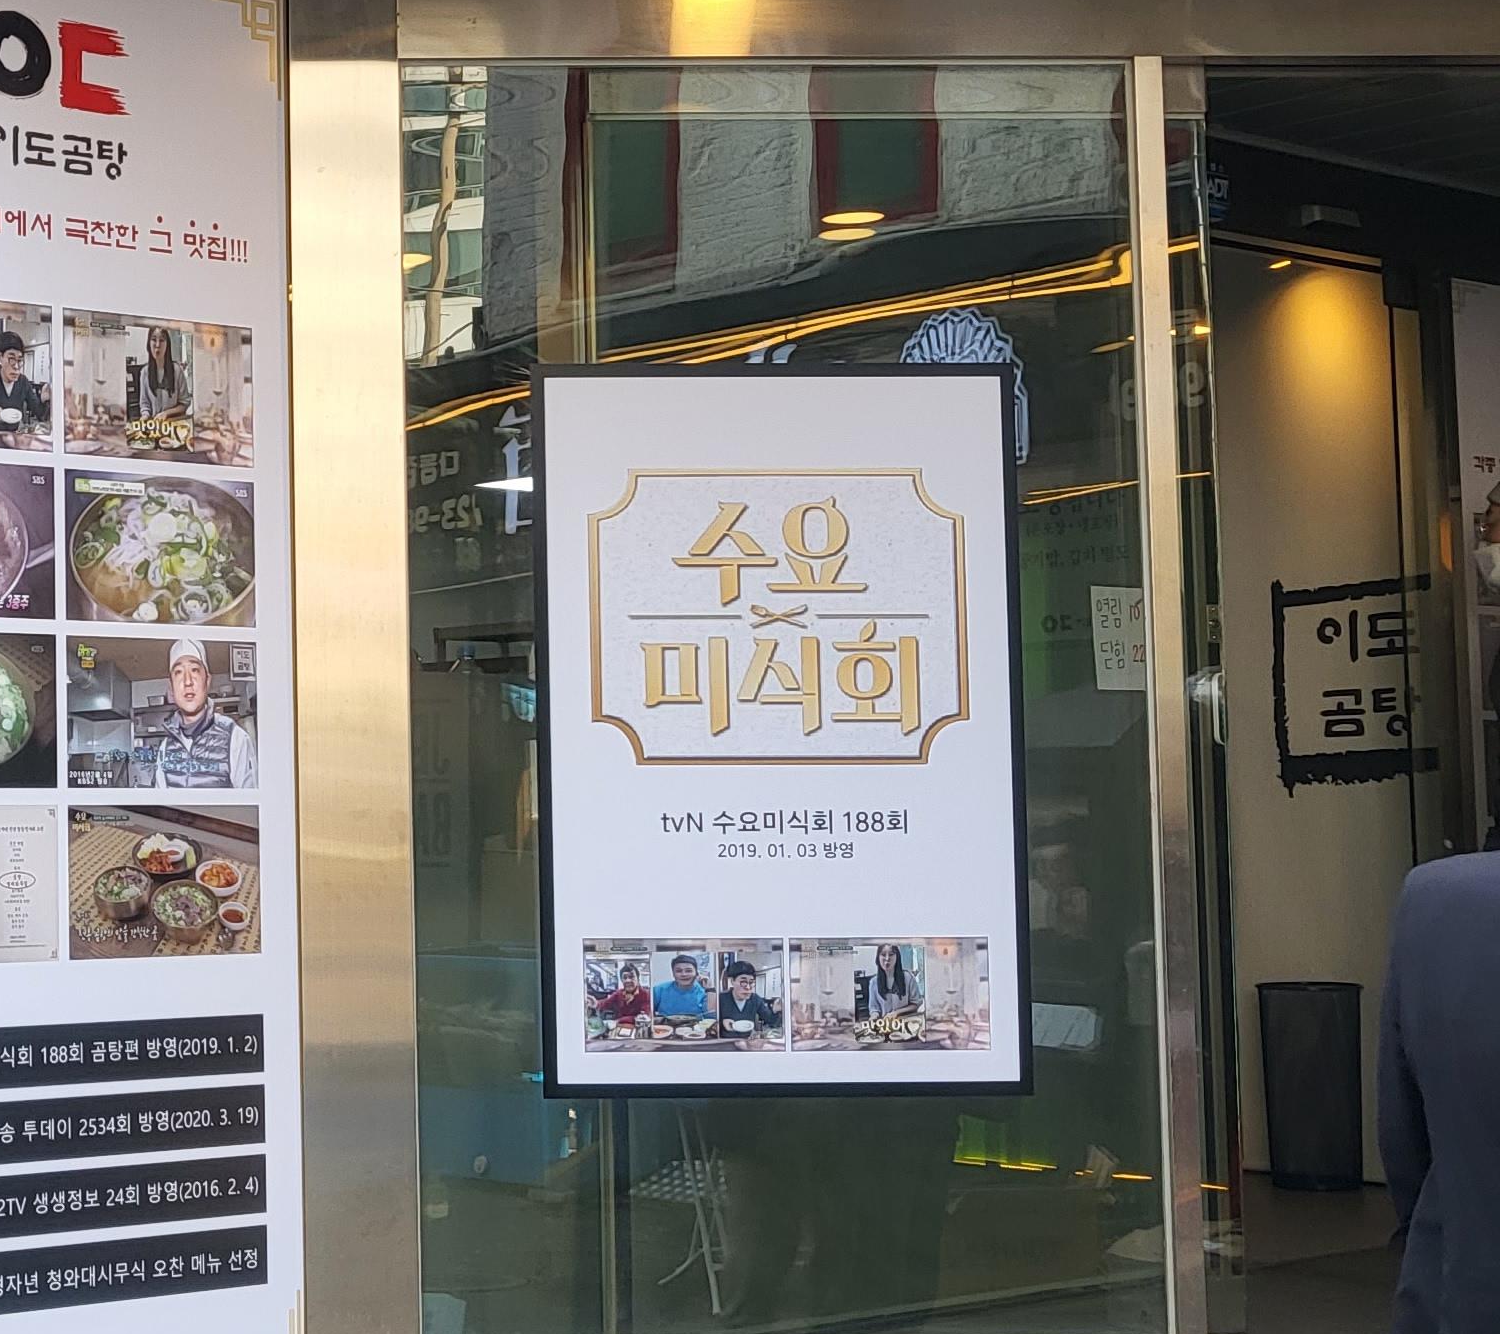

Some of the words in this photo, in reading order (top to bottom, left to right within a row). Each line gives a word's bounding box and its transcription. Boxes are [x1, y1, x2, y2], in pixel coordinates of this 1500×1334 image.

[64, 217, 139, 252] 극찬한
[149, 223, 173, 254] 그
[182, 227, 249, 264] 맛집!!!
[672, 495, 868, 606] 수요
[1096, 598, 1122, 629] 열림
[1100, 639, 1125, 670] 닫힘
[1317, 609, 1420, 663] 이도
[639, 618, 921, 737] 미식회
[661, 811, 703, 835] tvN
[712, 809, 834, 836] 수요미식회
[842, 809, 910, 836] 188회
[718, 842, 762, 860] 2019.
[768, 842, 792, 860] 01.
[798, 842, 818, 860] 03
[823, 840, 855, 860] 방영
[41, 1041, 84, 1065] 188회
[90, 1039, 140, 1063] 곰탕편
[244, 1035, 258, 1055] 2)
[22, 1118, 72, 1141] 투데이
[78, 1113, 131, 1138] 2534회
[237, 1106, 259, 1127] 19)
[33, 1189, 100, 1215] 생생정보
[106, 1184, 141, 1207] 24회
[245, 1176, 259, 1197] 4)
[46, 1259, 146, 1292] 청와대시무식
[152, 1256, 185, 1279] 오찬
[191, 1252, 222, 1274] 메뉴
[228, 1247, 259, 1270] 선정
